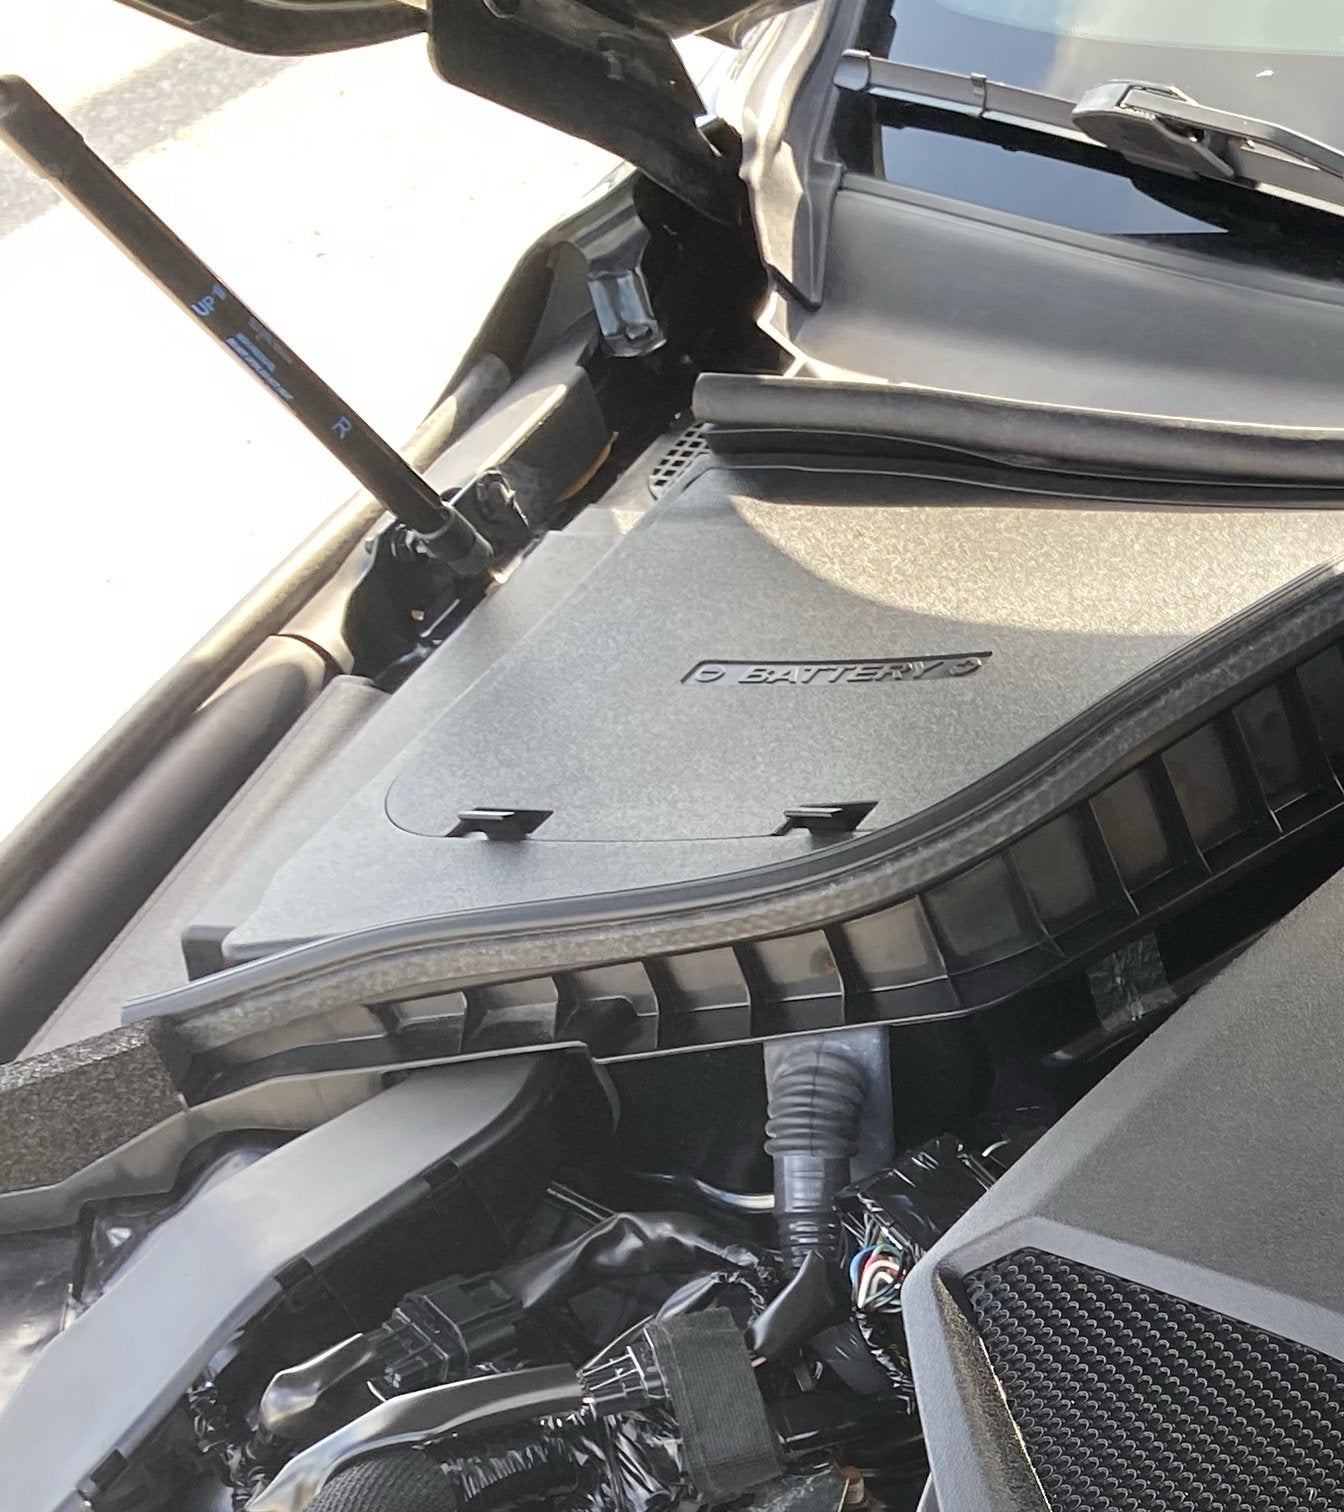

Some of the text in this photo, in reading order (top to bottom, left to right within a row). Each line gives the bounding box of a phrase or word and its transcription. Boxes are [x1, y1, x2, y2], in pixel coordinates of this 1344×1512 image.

[191, 295, 215, 317] UP
[332, 415, 351, 439] R
[737, 660, 944, 685] BATTERY
